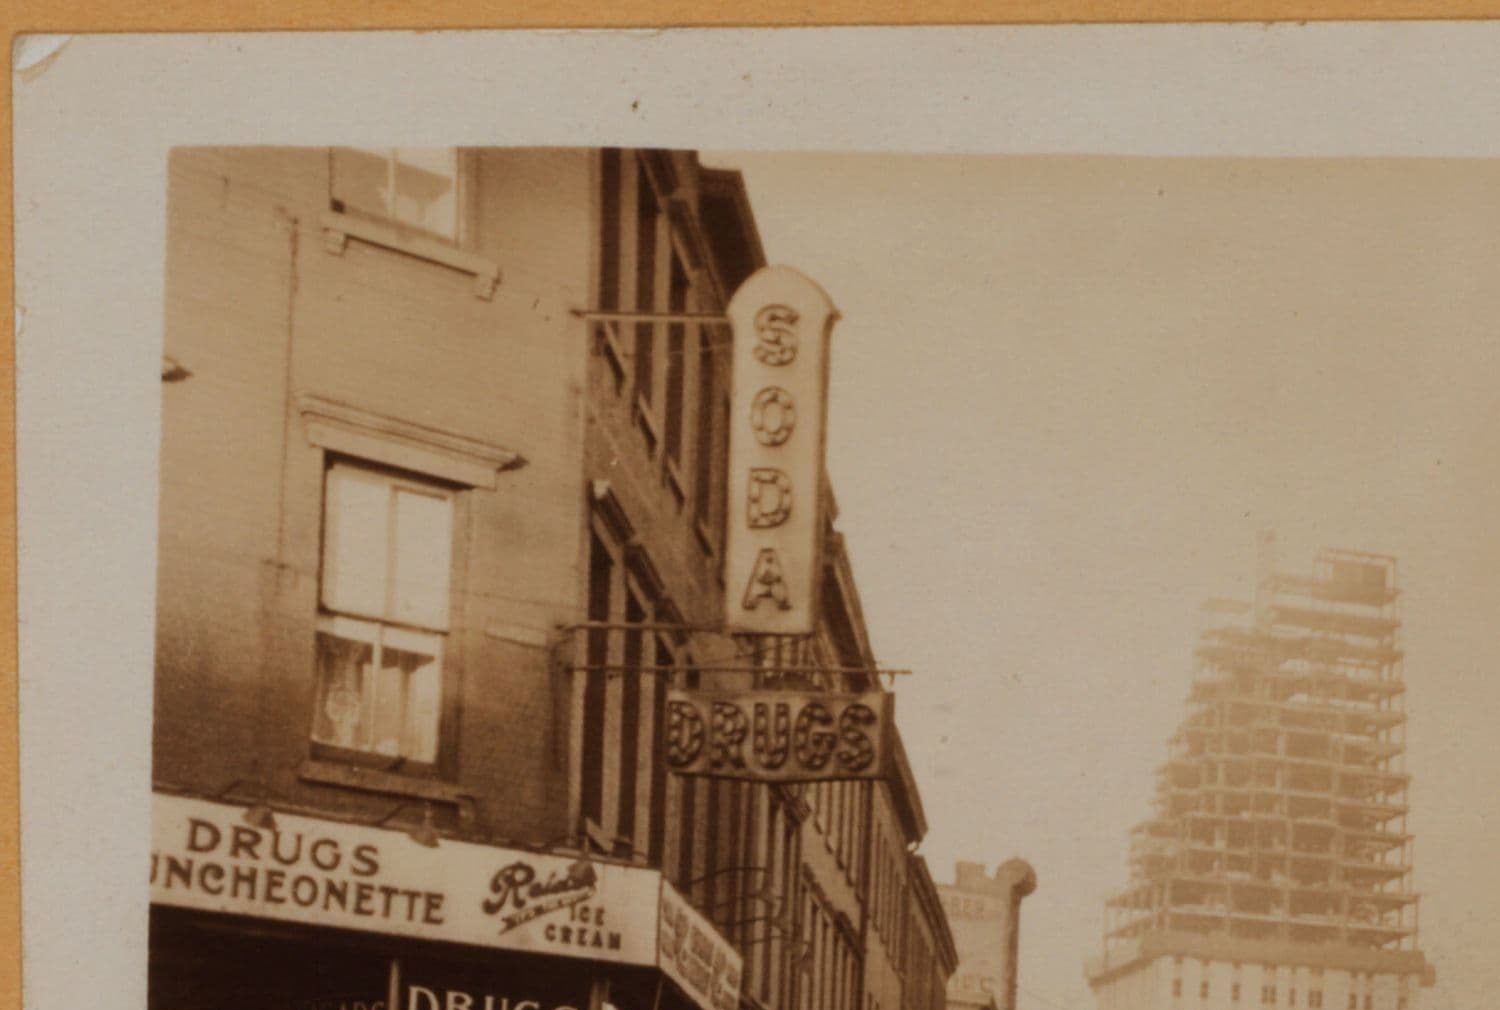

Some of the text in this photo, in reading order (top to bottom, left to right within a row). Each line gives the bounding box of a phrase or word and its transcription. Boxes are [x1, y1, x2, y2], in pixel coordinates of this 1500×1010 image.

[740, 303, 798, 612] SODA
[666, 700, 878, 772] DRUGS
[186, 817, 380, 877] DRUGS
[544, 924, 621, 950] CREAM
[570, 902, 605, 927] ICE
